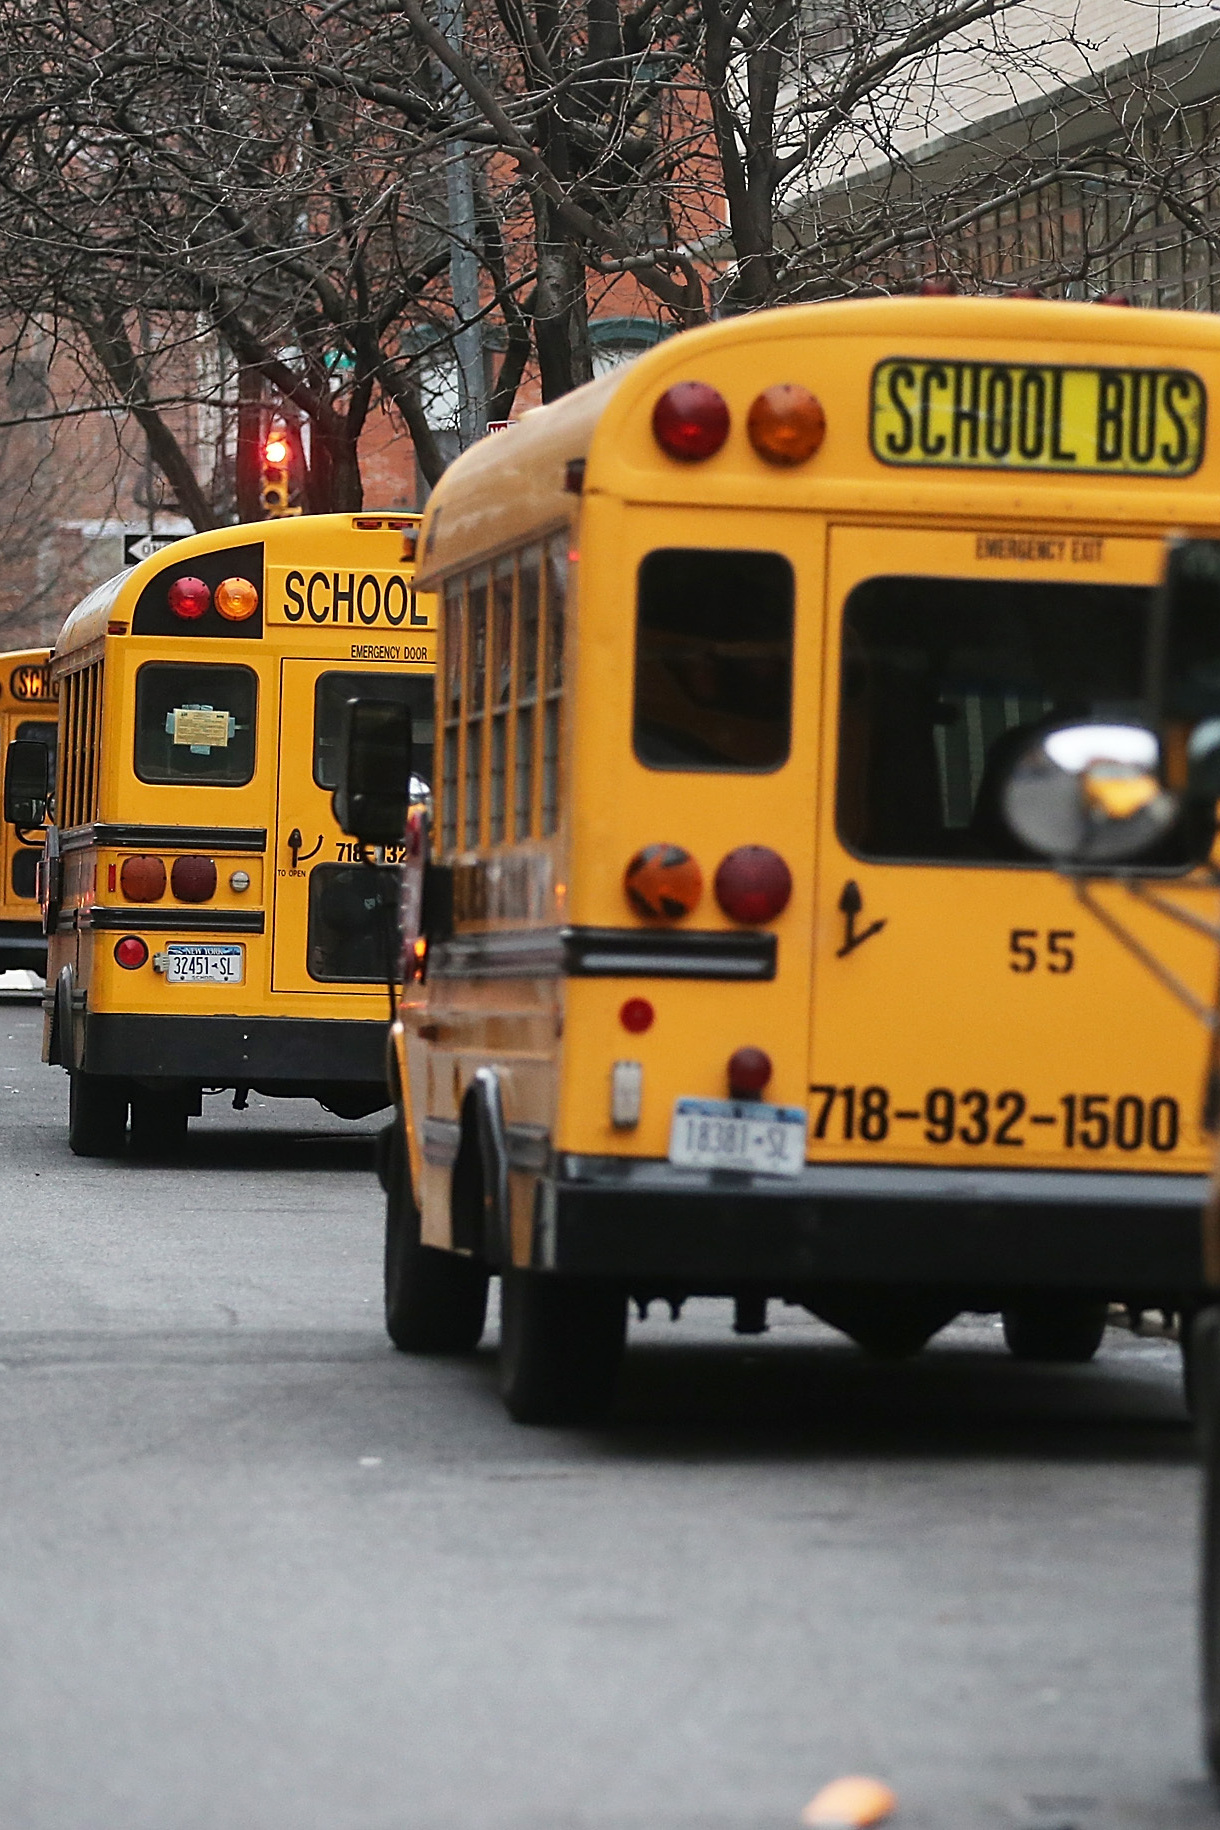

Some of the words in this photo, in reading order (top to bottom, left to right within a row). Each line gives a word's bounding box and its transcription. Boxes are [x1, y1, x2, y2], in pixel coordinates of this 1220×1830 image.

[886, 364, 1076, 462] SCHOOL
[1095, 368, 1191, 466] BUS
[976, 535, 1065, 561] EMERGENCY
[283, 570, 428, 626] SCHOOL
[351, 644, 400, 659] EMERGENCY
[404, 646, 428, 660] DOOR
[336, 842, 407, 864] 718-32
[278, 869, 286, 877] TO
[288, 869, 306, 878] OPEN
[185, 947, 202, 955] NEW
[1008, 929, 1076, 974] 55
[808, 1084, 1180, 1152] 718-932-1500
